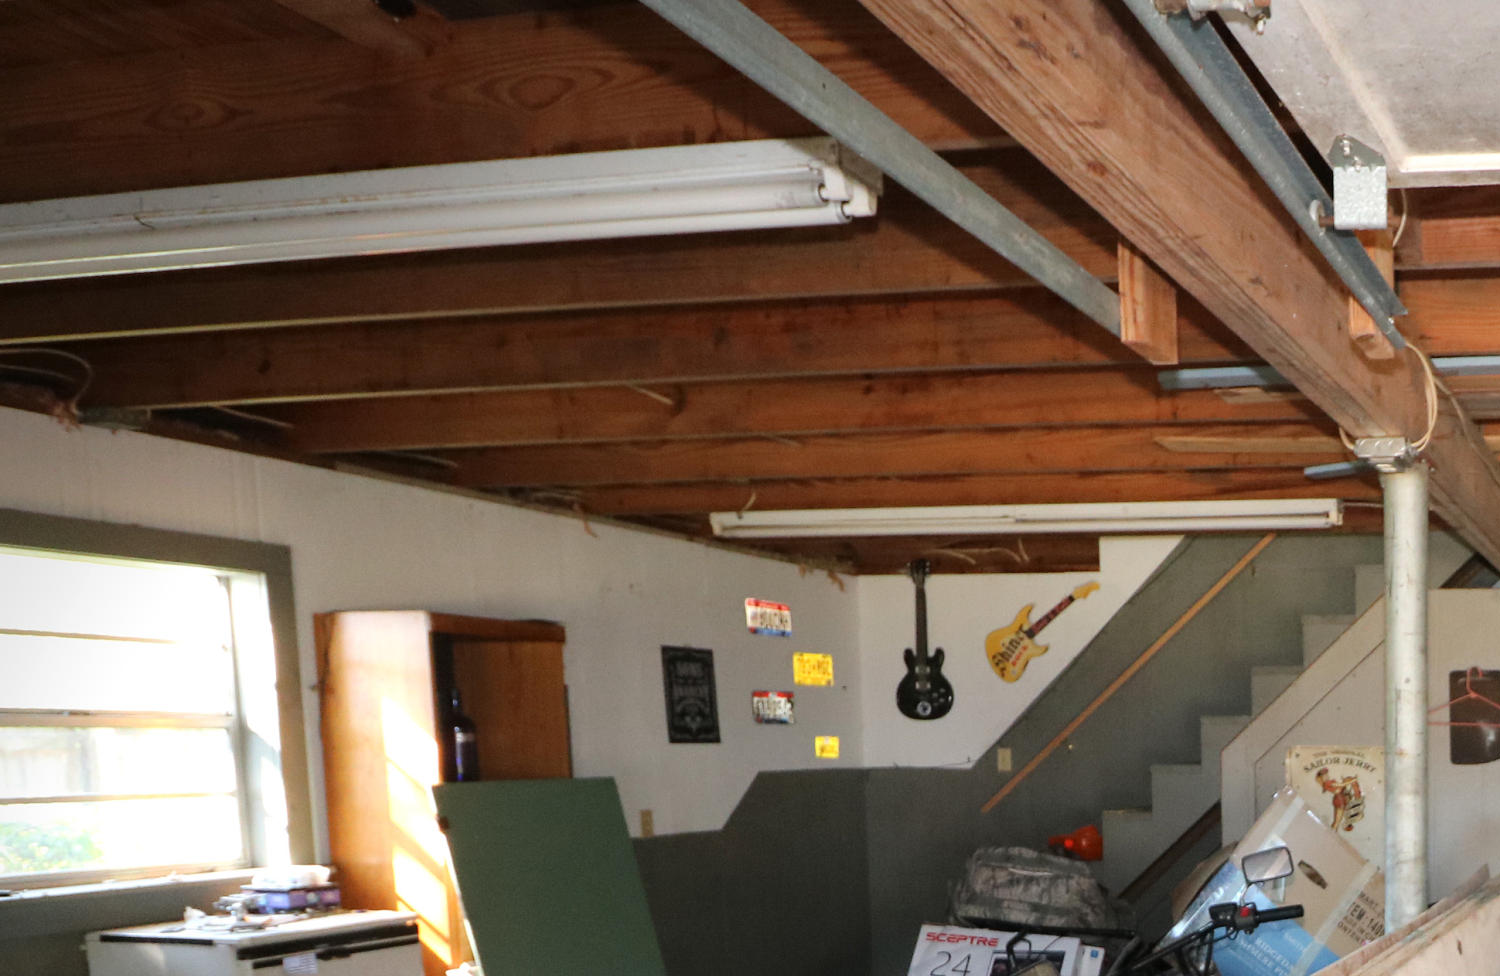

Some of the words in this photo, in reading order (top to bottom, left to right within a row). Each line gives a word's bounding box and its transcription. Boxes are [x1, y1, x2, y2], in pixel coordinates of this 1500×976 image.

[1303, 757, 1341, 773] SAILOR
[1344, 757, 1377, 773] JERRY
[925, 932, 1000, 948] SCEPTRE
